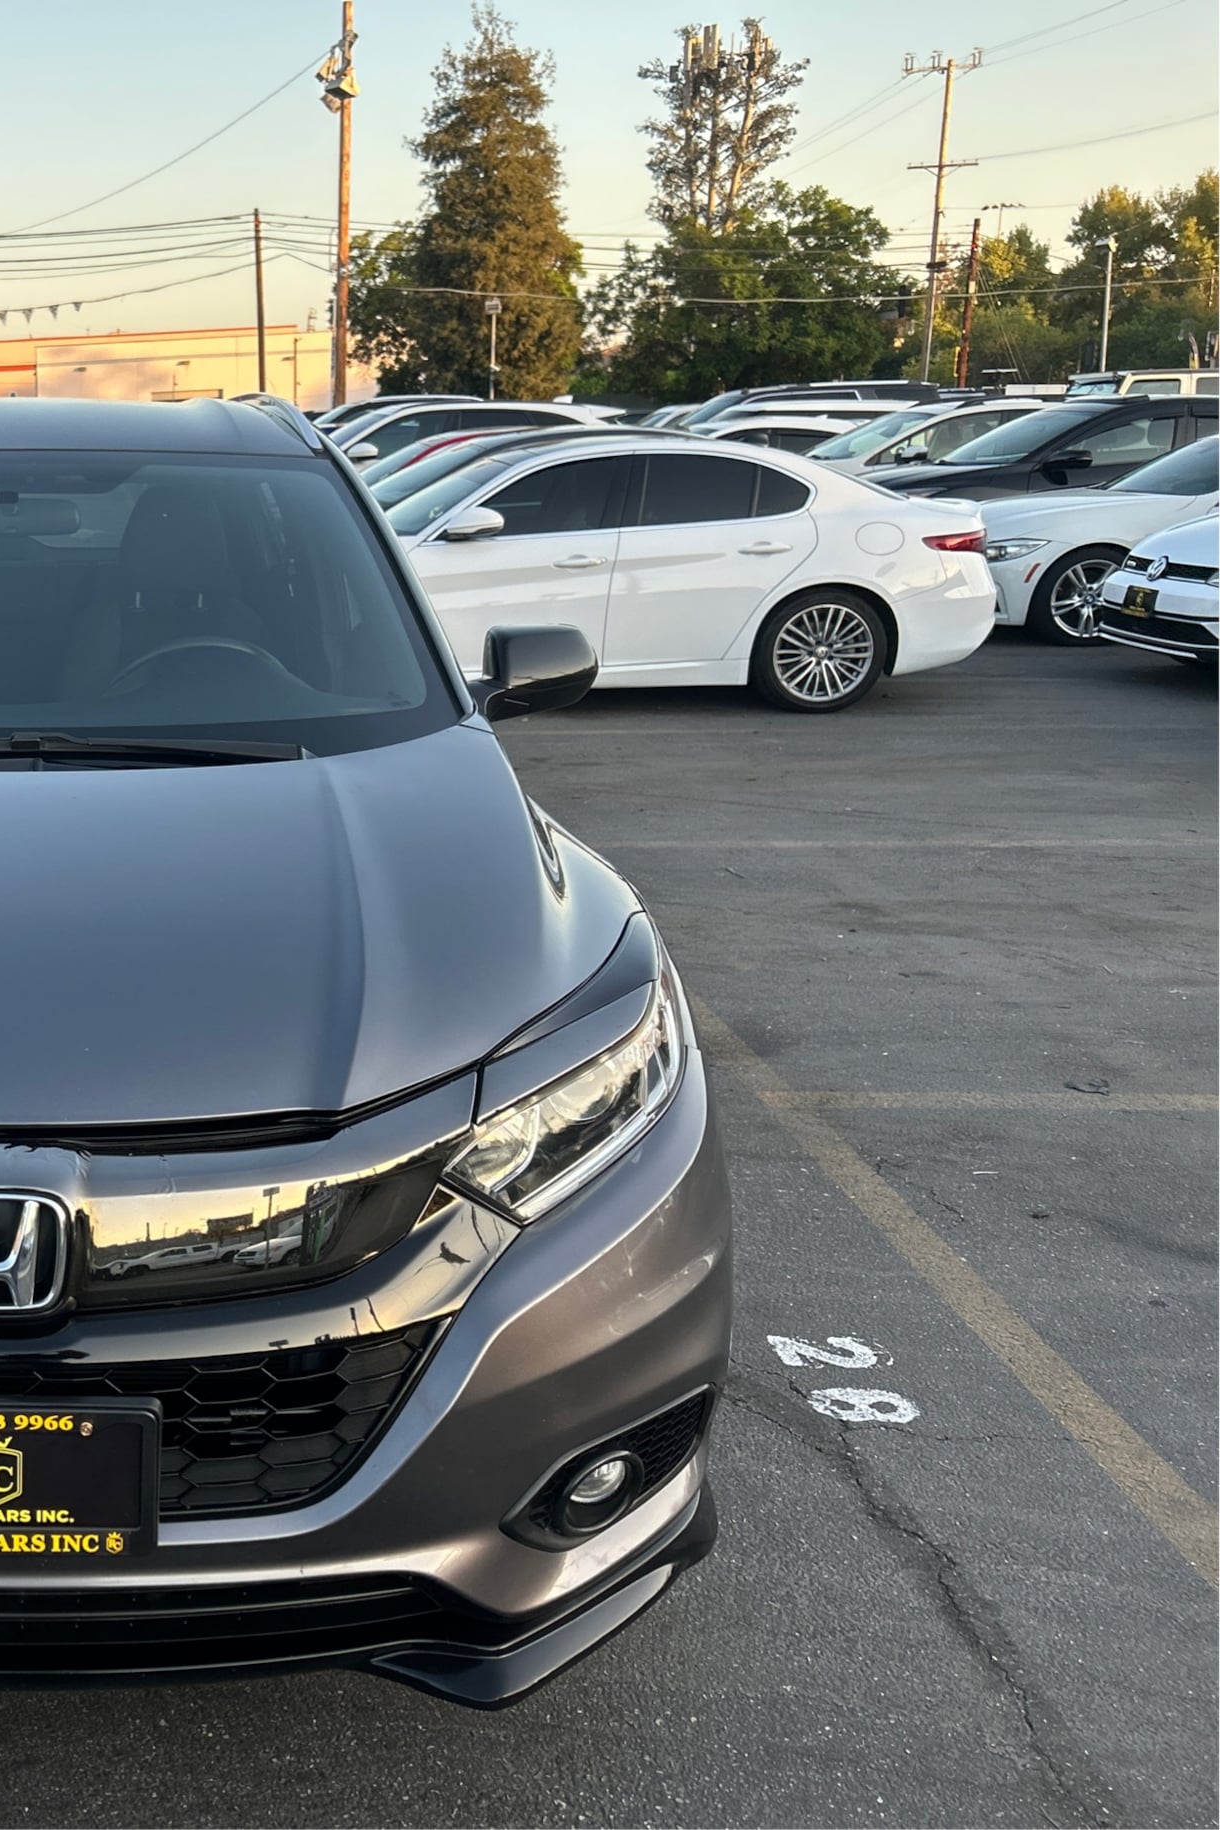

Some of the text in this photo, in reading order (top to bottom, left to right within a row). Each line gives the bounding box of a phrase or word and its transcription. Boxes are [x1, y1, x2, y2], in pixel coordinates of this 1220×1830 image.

[13, 1414, 74, 1431] 9966
[36, 1509, 75, 1524] INC.
[51, 1534, 100, 1553] INC
